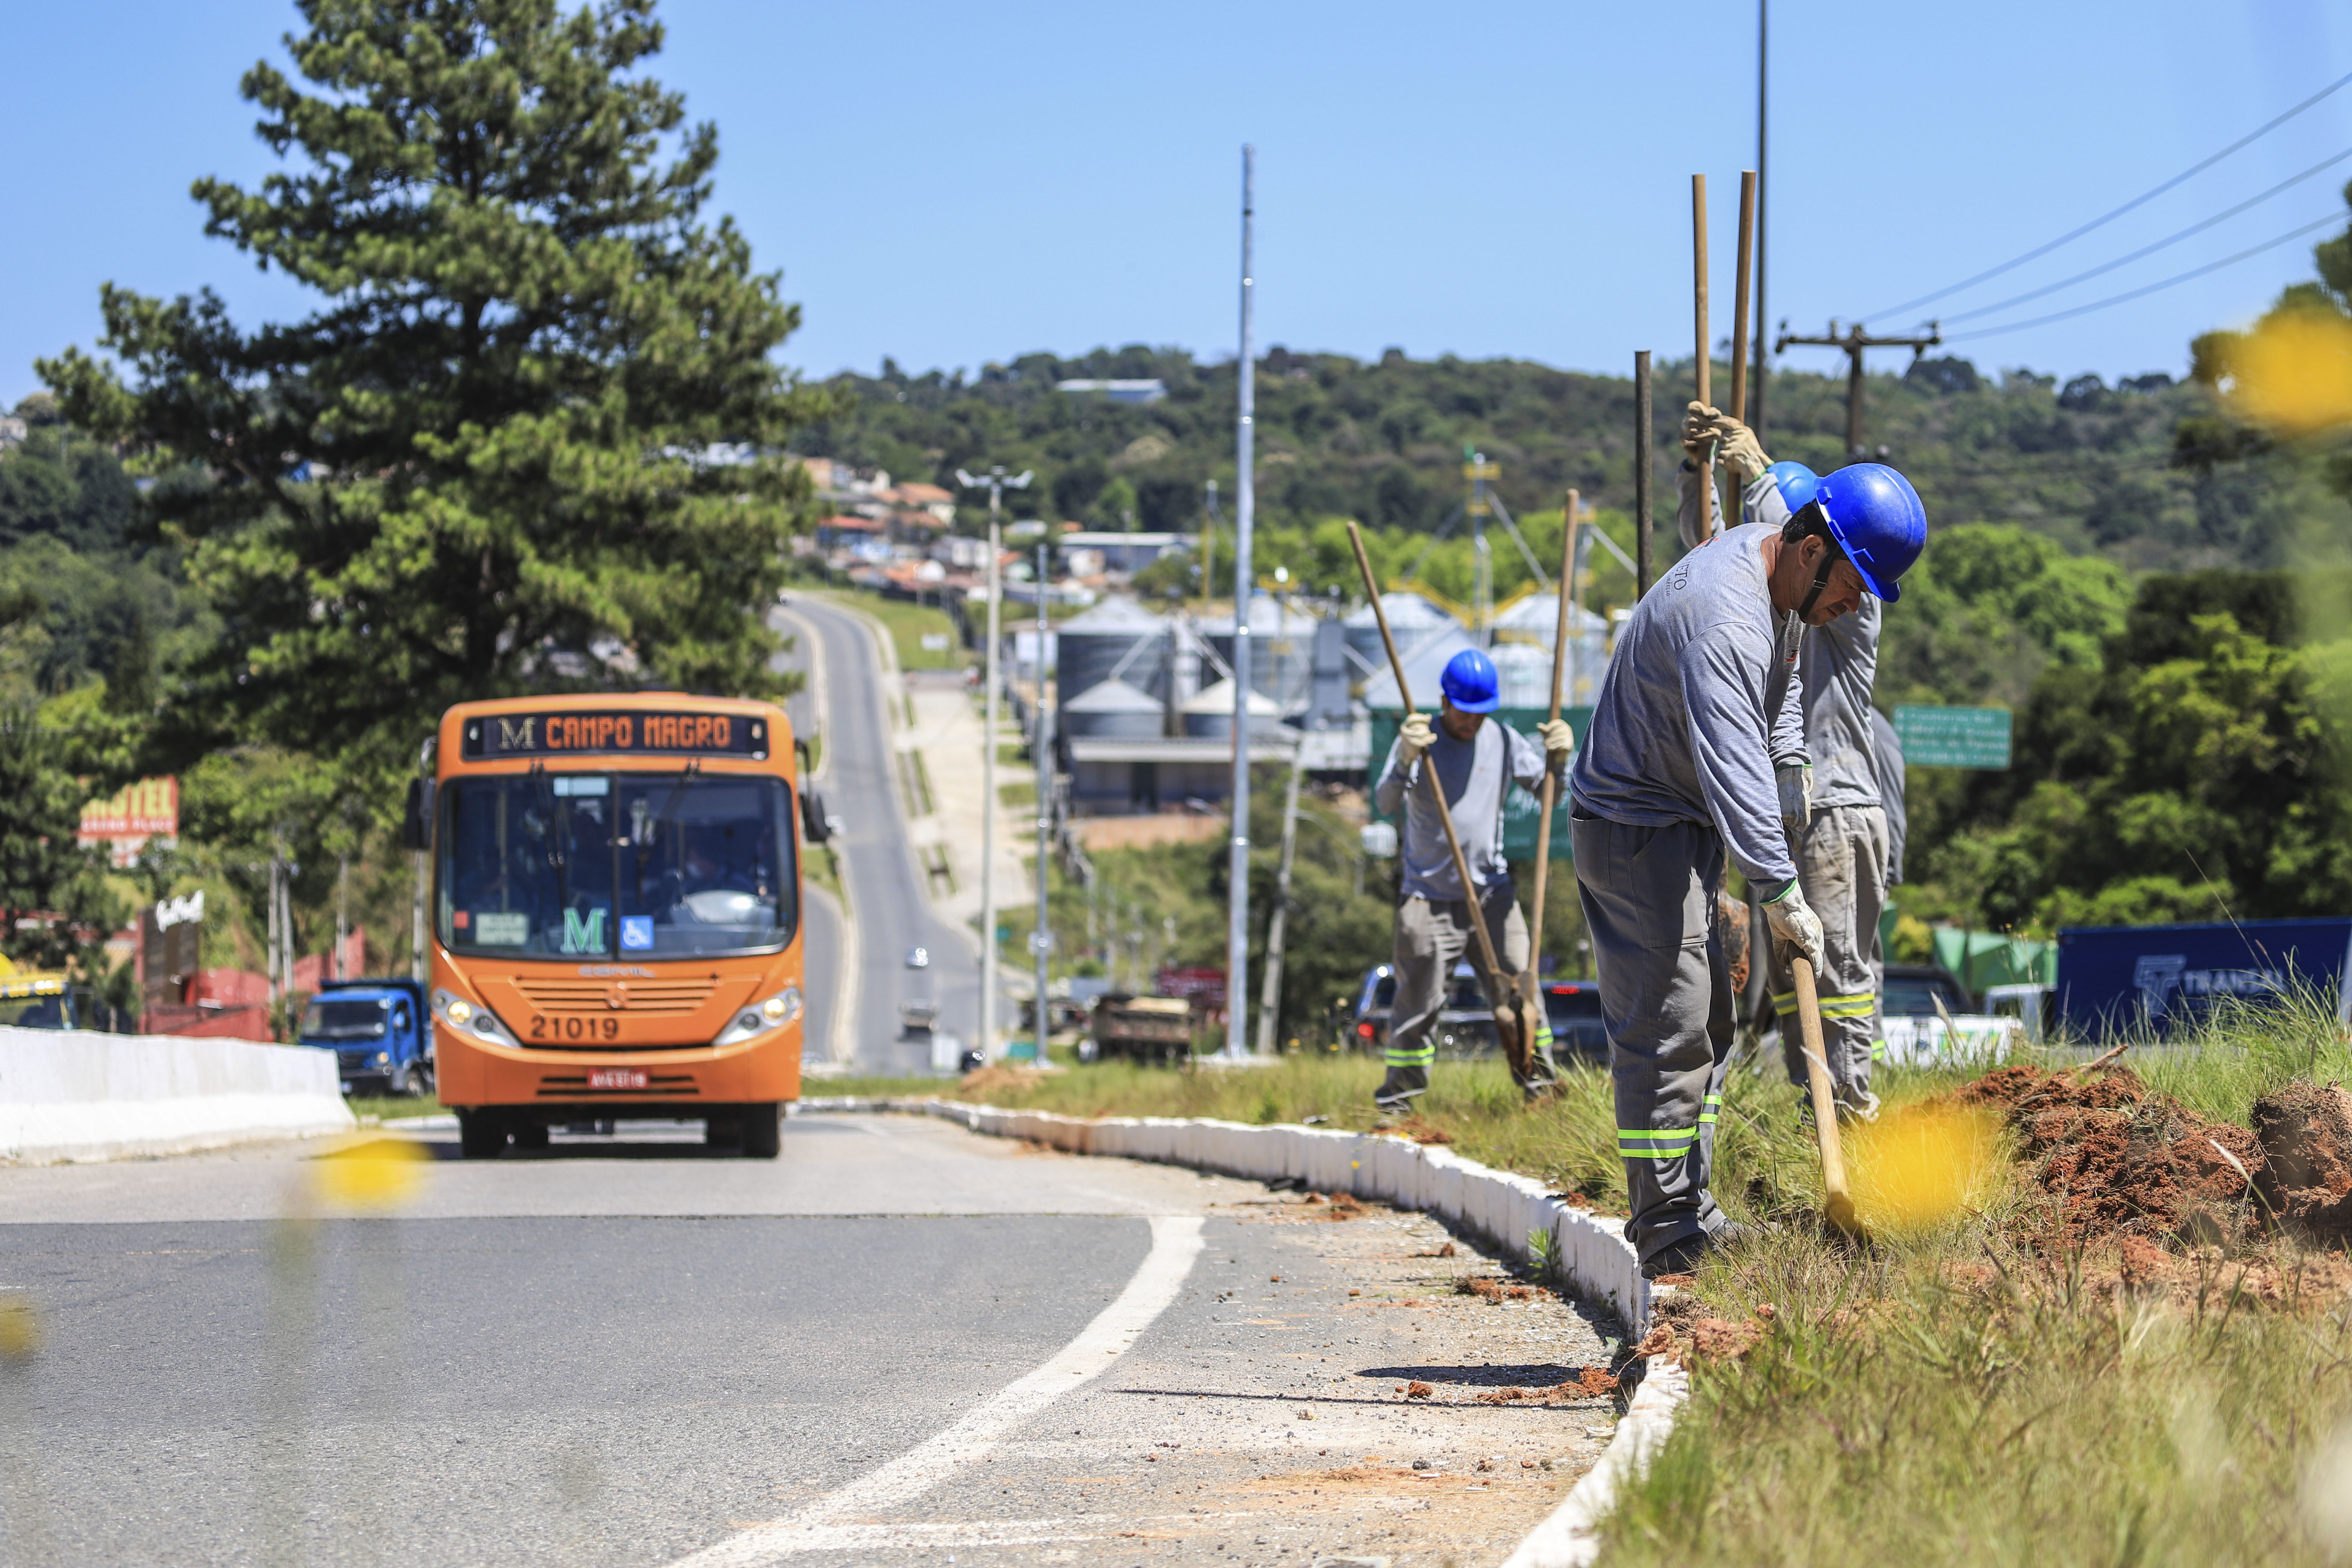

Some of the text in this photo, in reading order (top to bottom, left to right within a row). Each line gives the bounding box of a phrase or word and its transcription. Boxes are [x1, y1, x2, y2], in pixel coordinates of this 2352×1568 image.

[546, 717, 633, 749] CAMPO
[644, 716, 731, 748] MAGRO
[531, 1015, 619, 1039] 21019
